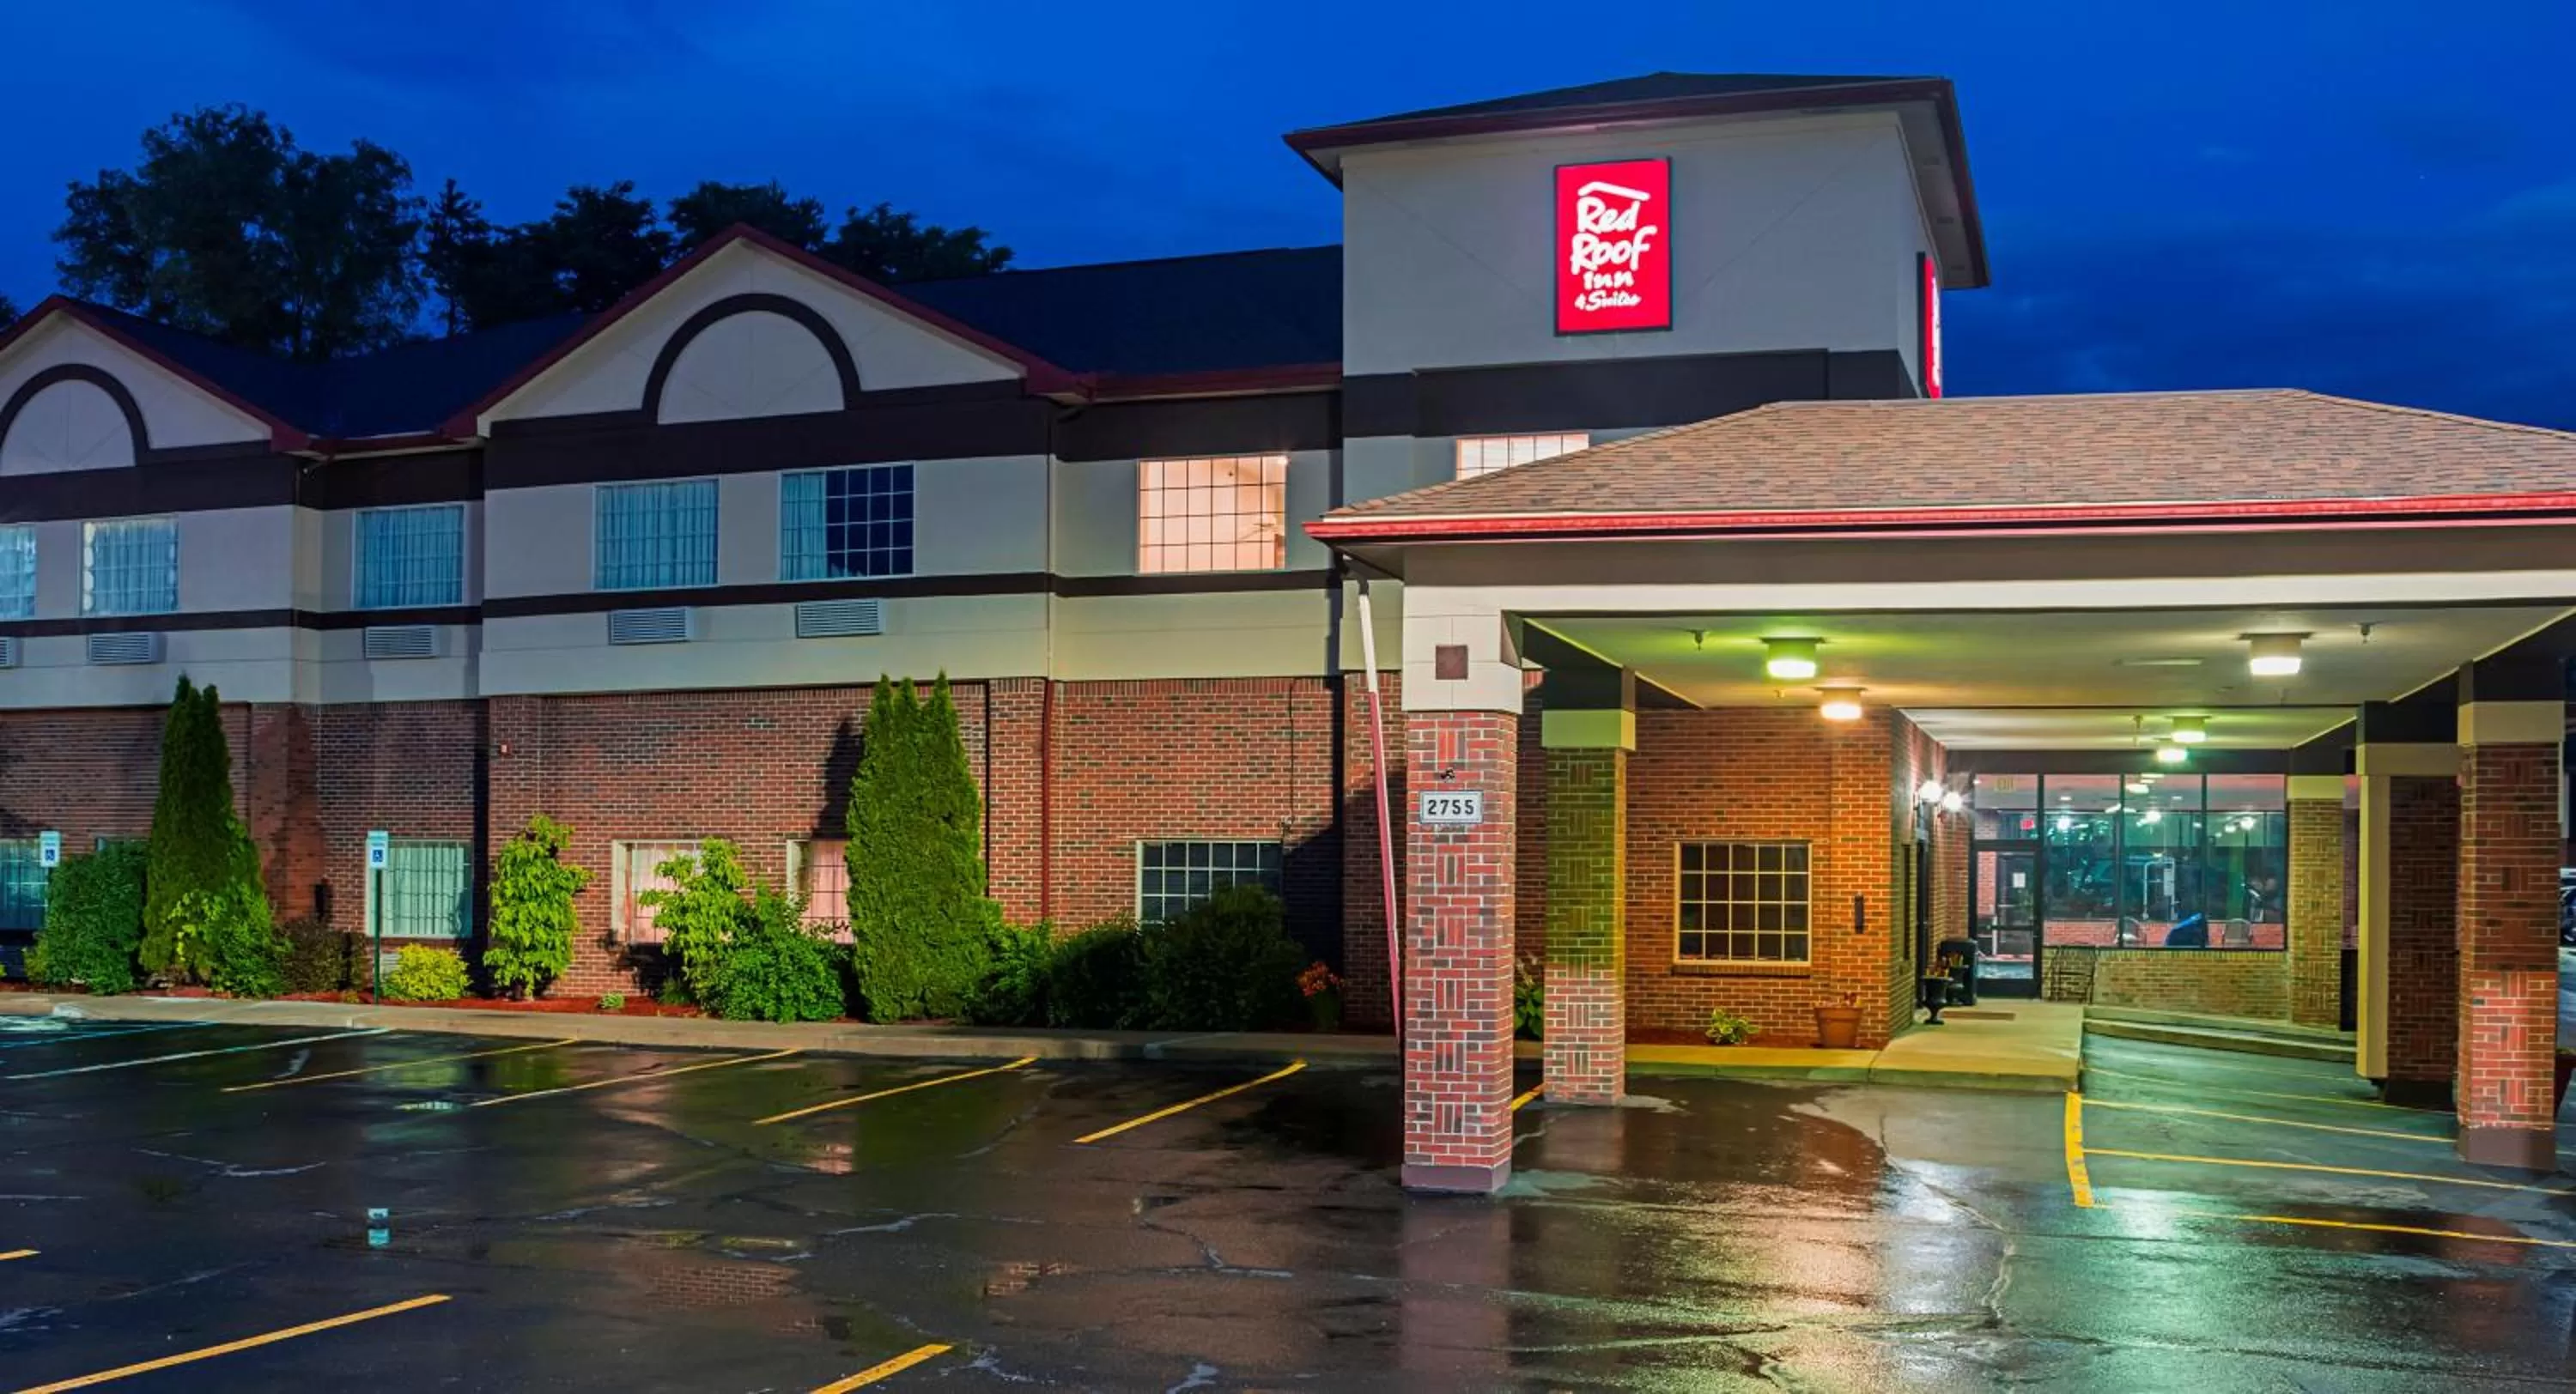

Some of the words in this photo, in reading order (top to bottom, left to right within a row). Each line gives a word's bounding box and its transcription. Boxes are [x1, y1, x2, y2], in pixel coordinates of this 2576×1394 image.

[1577, 196, 1641, 234] Red
[1570, 225, 1657, 276] Roof
[1427, 799, 1474, 815] 2755
